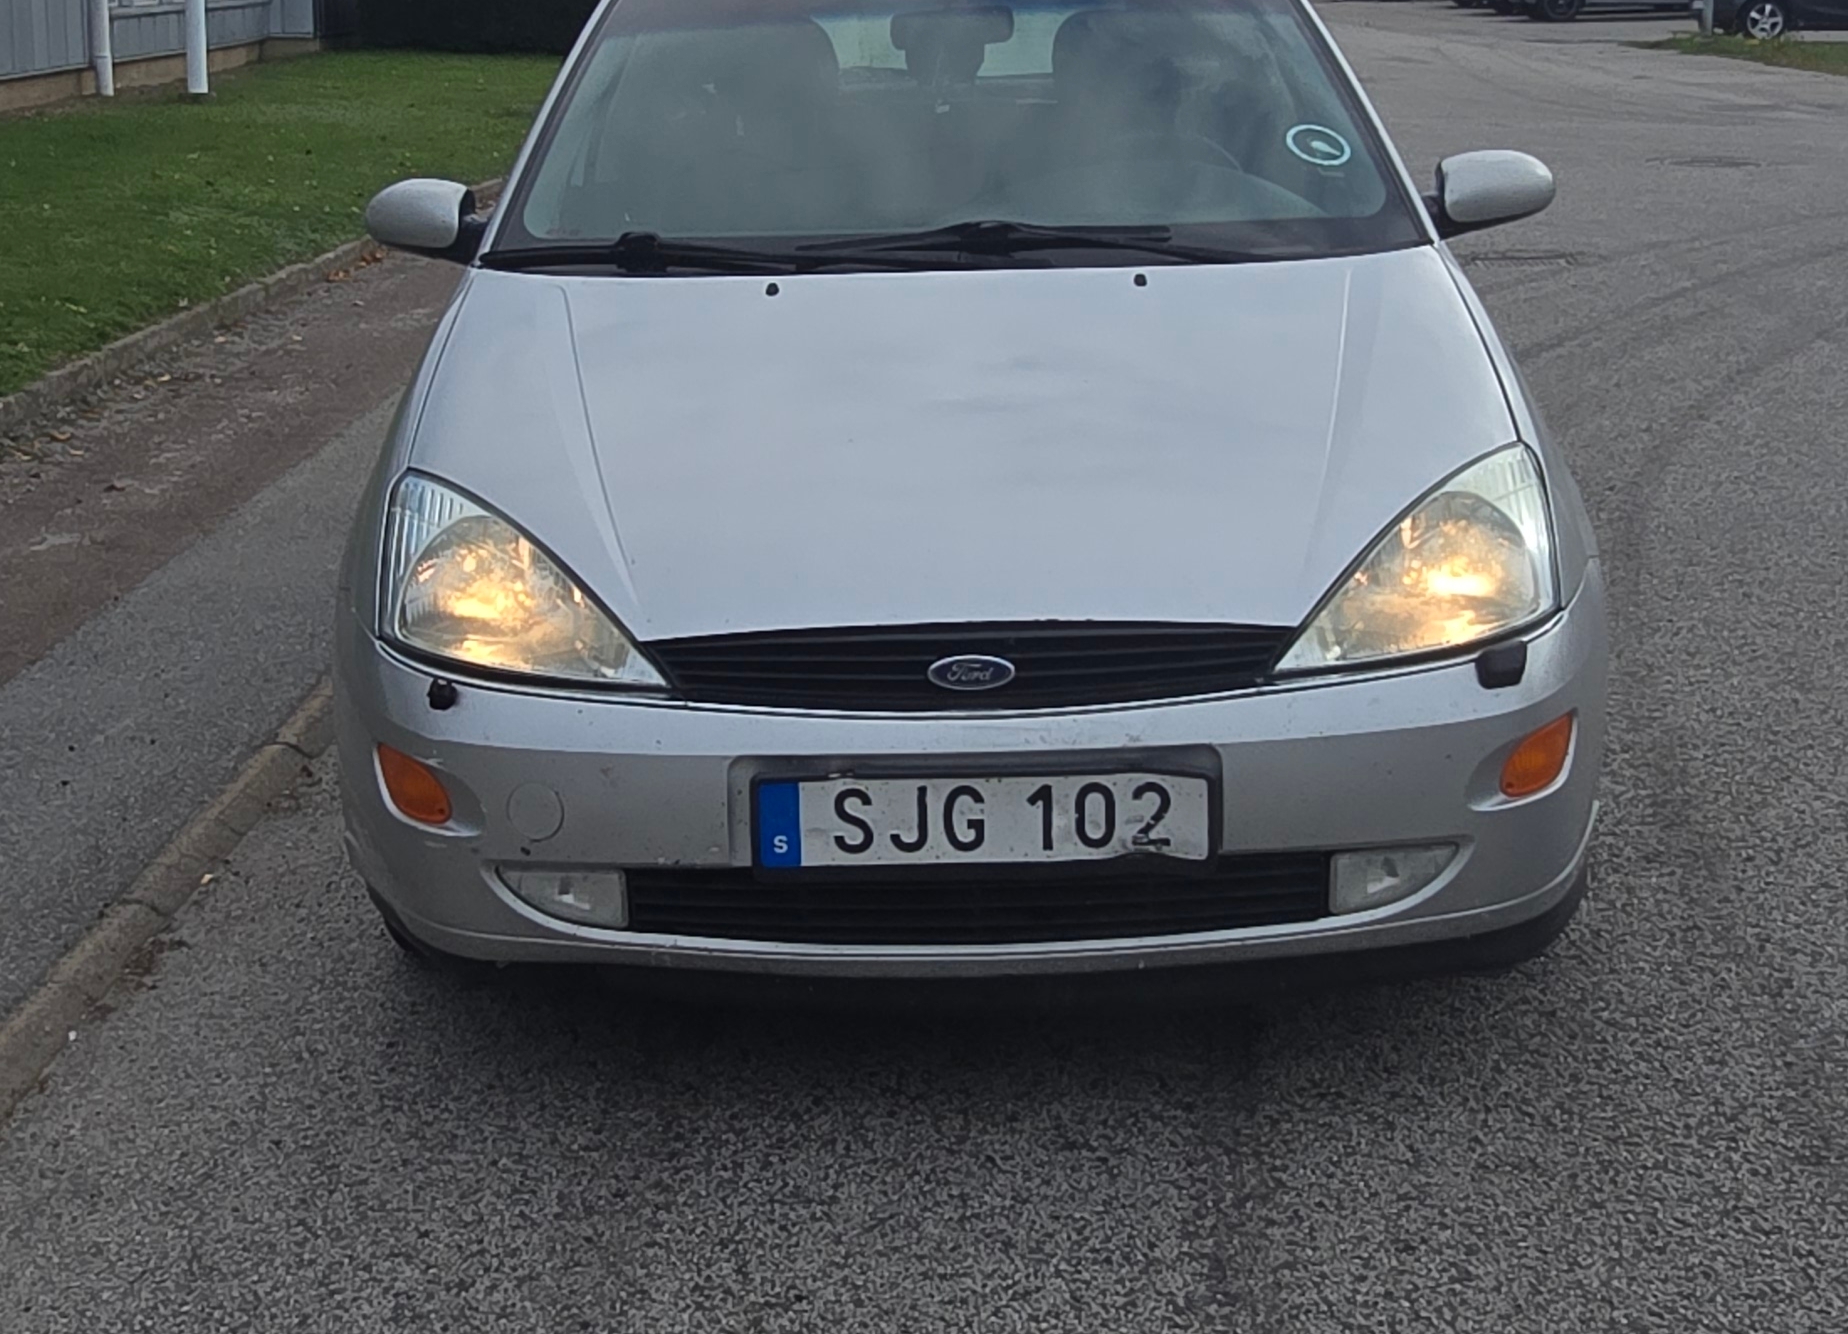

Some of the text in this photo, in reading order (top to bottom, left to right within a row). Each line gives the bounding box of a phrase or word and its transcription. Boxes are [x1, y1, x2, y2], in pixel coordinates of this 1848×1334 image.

[946, 662, 994, 681] Ford
[833, 781, 1172, 854] SJG 102
[773, 835, 789, 854] S
